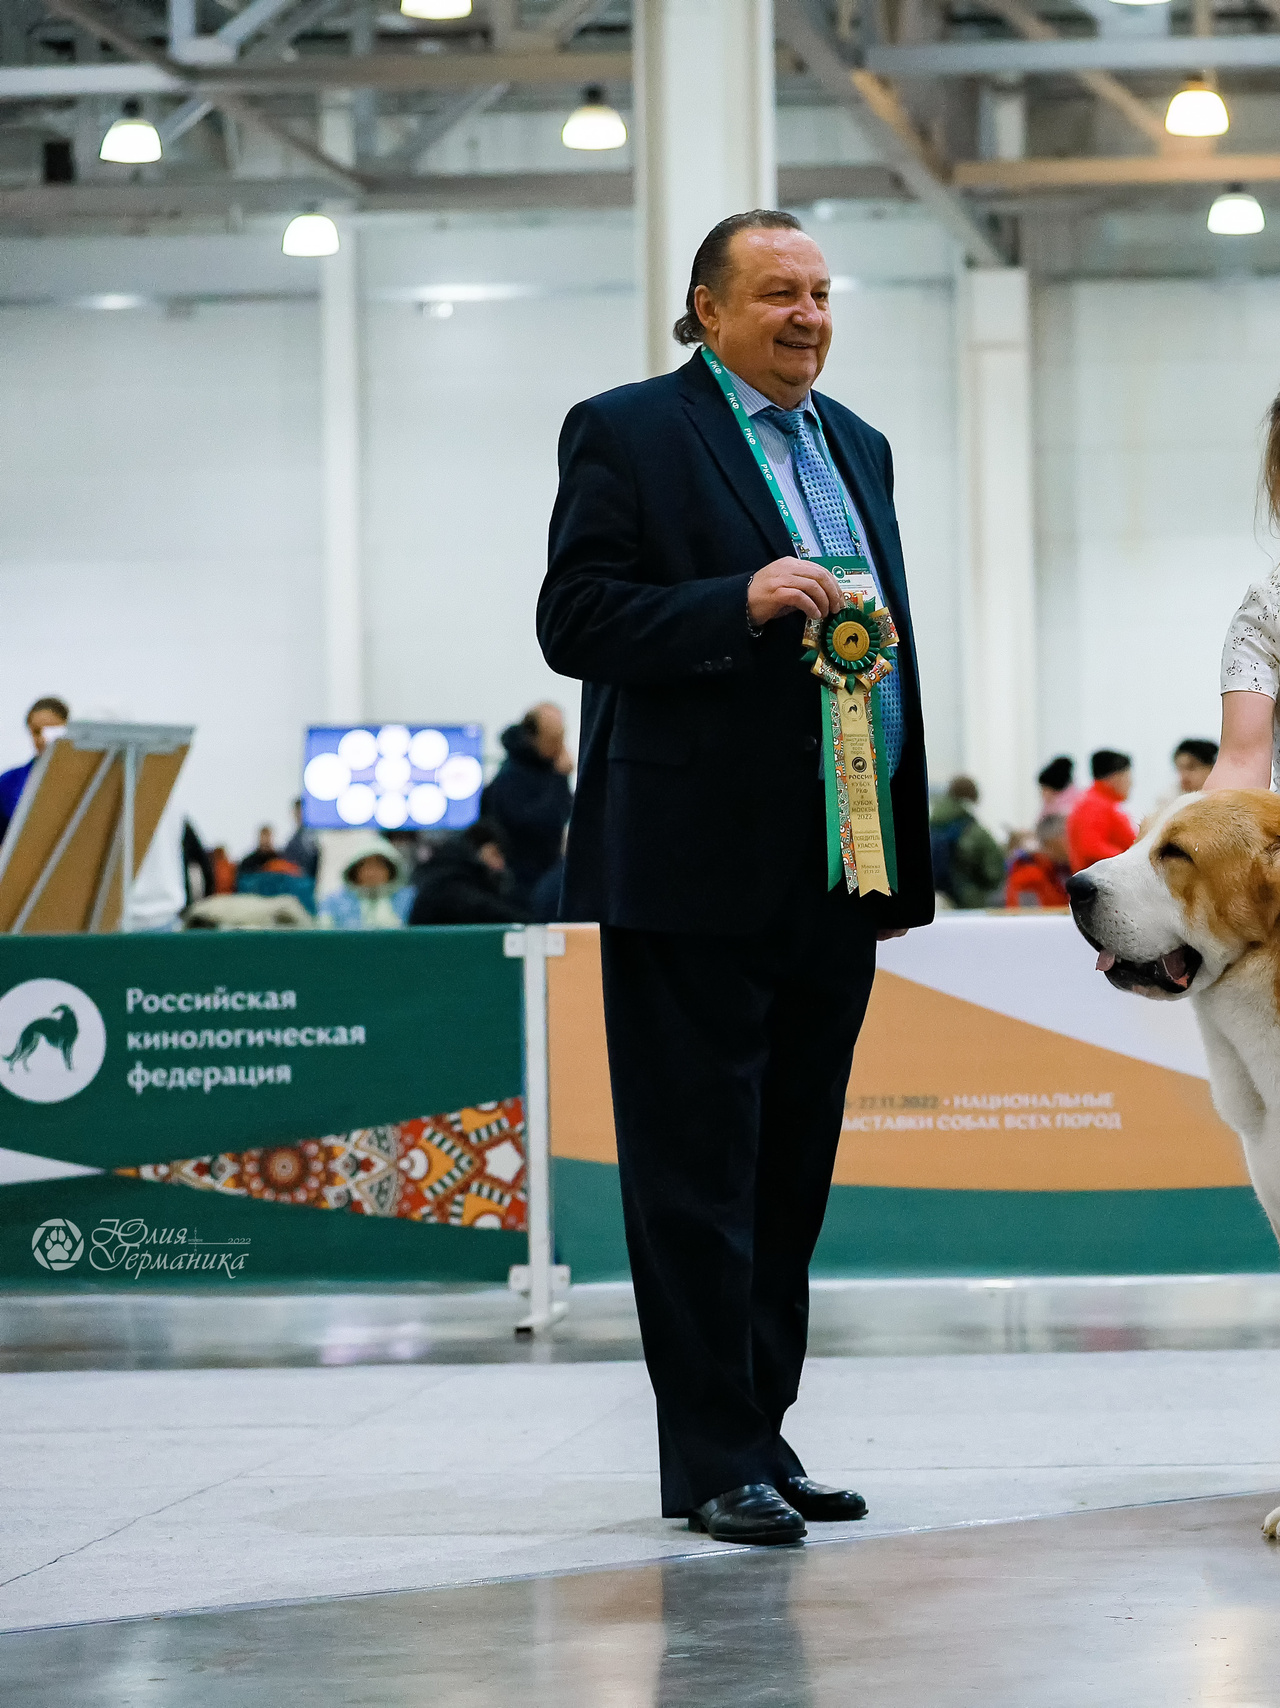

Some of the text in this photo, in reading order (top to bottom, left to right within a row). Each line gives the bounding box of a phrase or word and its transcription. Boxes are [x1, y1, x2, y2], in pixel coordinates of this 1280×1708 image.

[709, 360, 722, 375] РКФ
[726, 391, 740, 410] РКФ
[744, 427, 757, 446] РКФ
[760, 463, 773, 481] РКФ
[126, 984, 297, 1013] Российская
[126, 1025, 366, 1052] кинологическая
[126, 1059, 292, 1093] федерация
[953, 1091, 1115, 1110] НАЦИОНАЛЬНЫЕ
[936, 1114, 1001, 1131] СОБАК
[1004, 1113, 1052, 1130] ВСЕХ
[1055, 1112, 1123, 1131] ПОРОД
